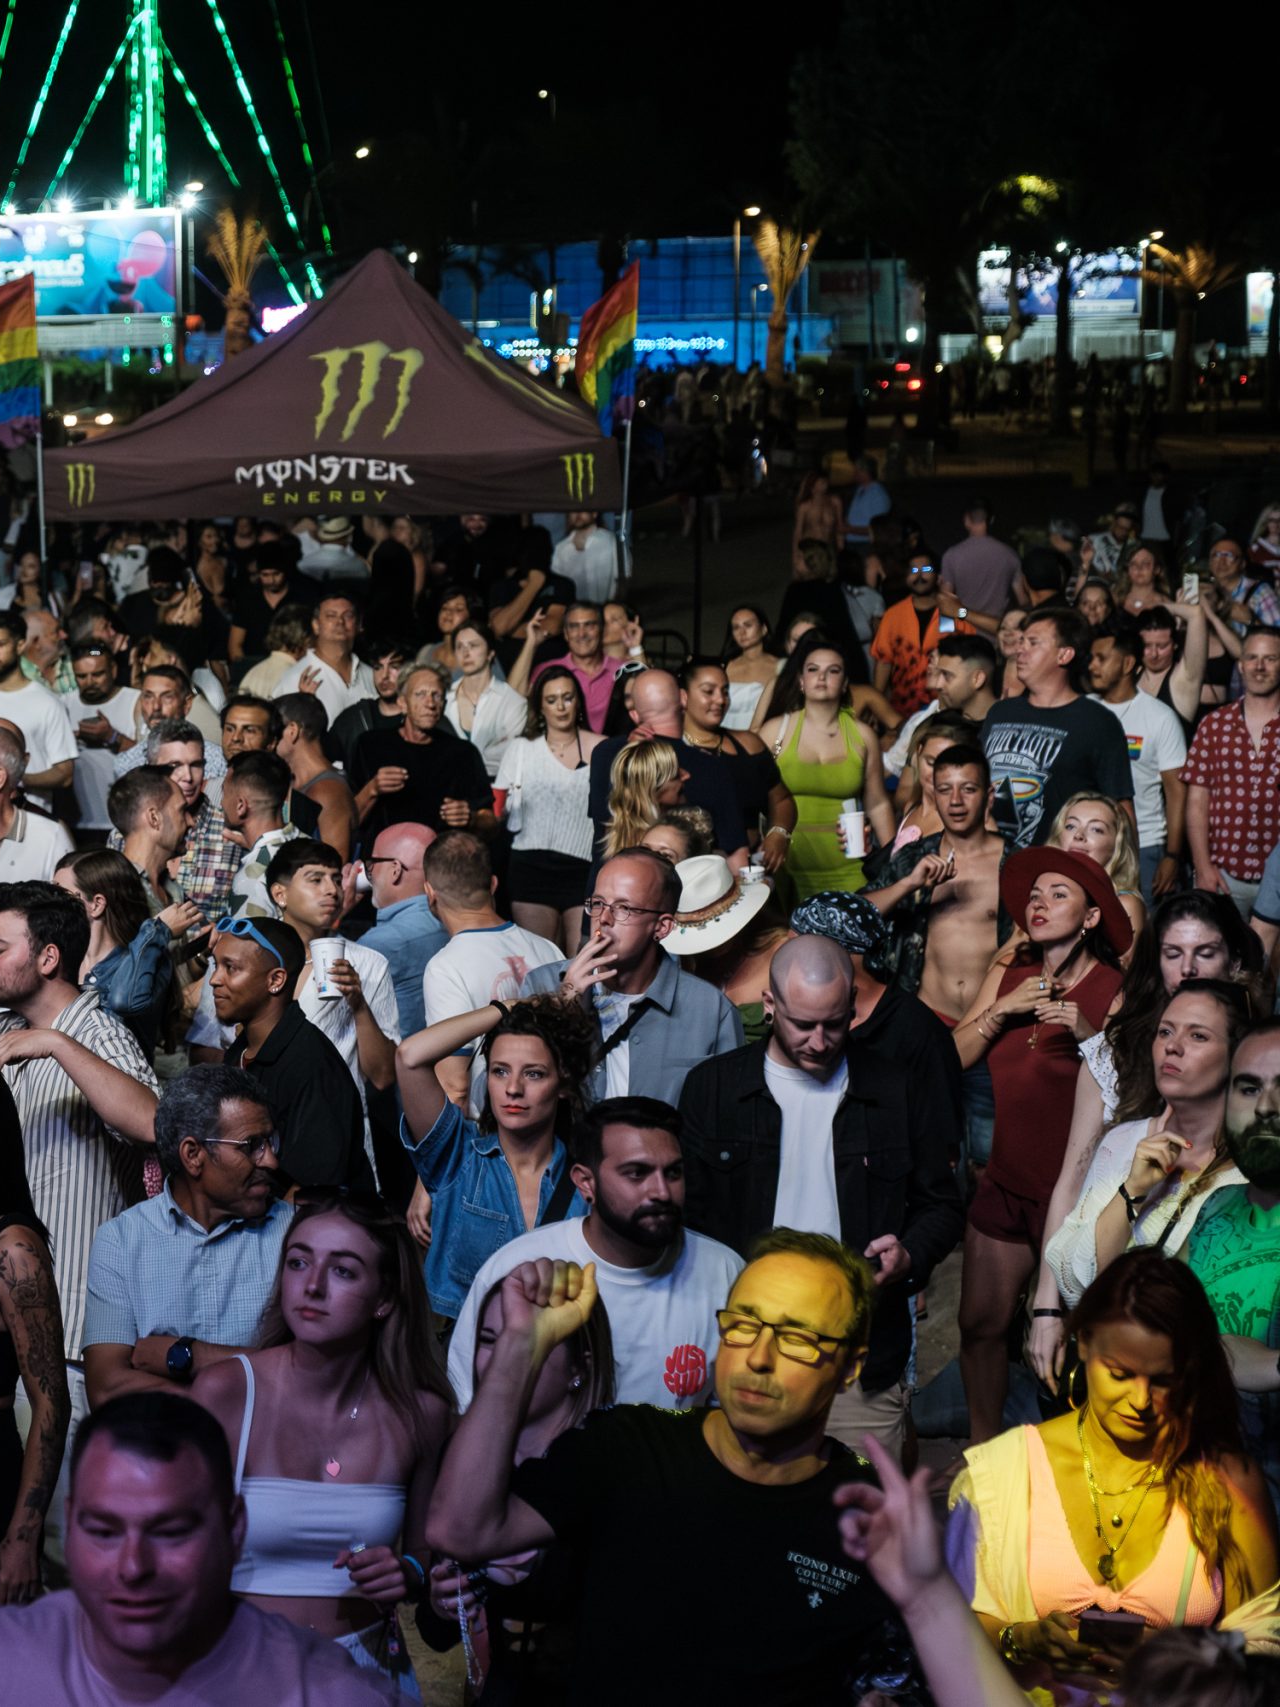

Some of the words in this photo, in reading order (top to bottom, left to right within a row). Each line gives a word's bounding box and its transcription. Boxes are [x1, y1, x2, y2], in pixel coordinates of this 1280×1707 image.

[262, 490, 388, 506] ENERGY
[665, 1344, 706, 1374] JUST
[786, 1550, 829, 1573] ICONO
[795, 1567, 847, 1591] COUTURE
